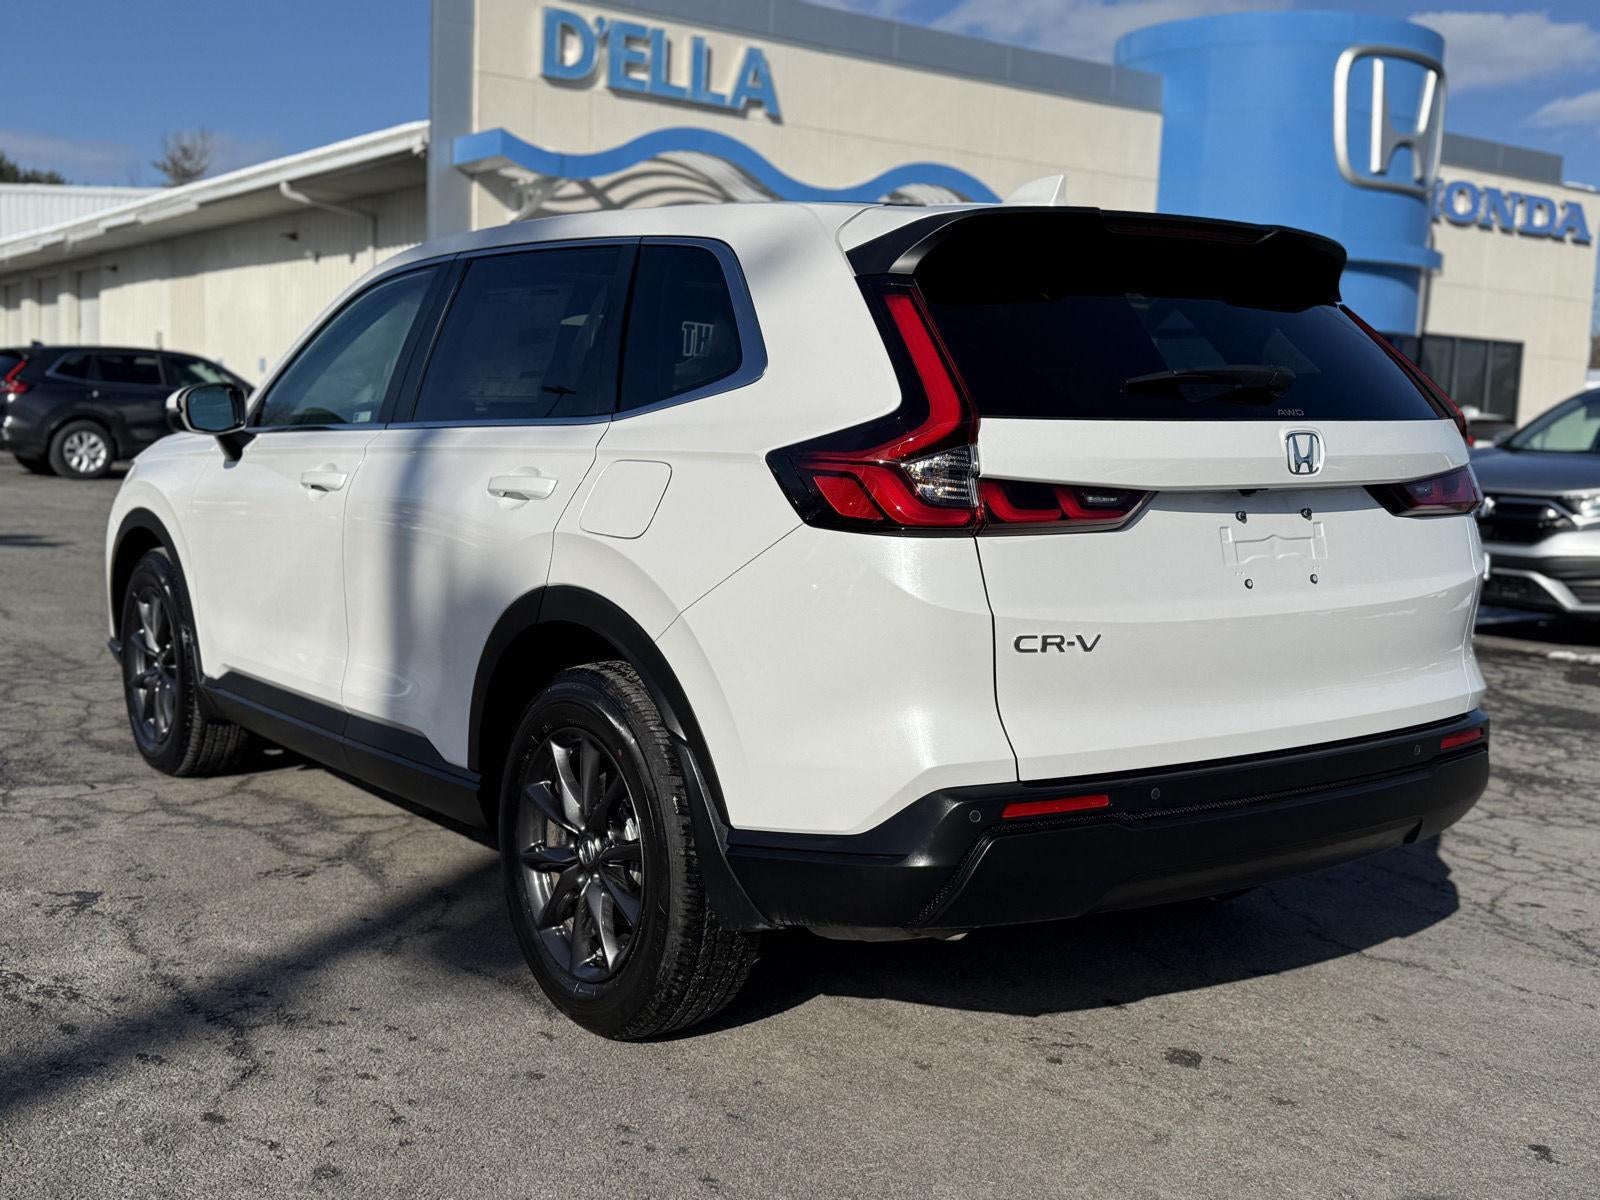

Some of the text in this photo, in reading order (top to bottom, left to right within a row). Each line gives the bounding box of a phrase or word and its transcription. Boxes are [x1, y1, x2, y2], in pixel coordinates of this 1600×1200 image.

[541, 6, 783, 123] D'ELLA
[1277, 408, 1304, 416] AWD
[1014, 634, 1101, 653] CR-V
